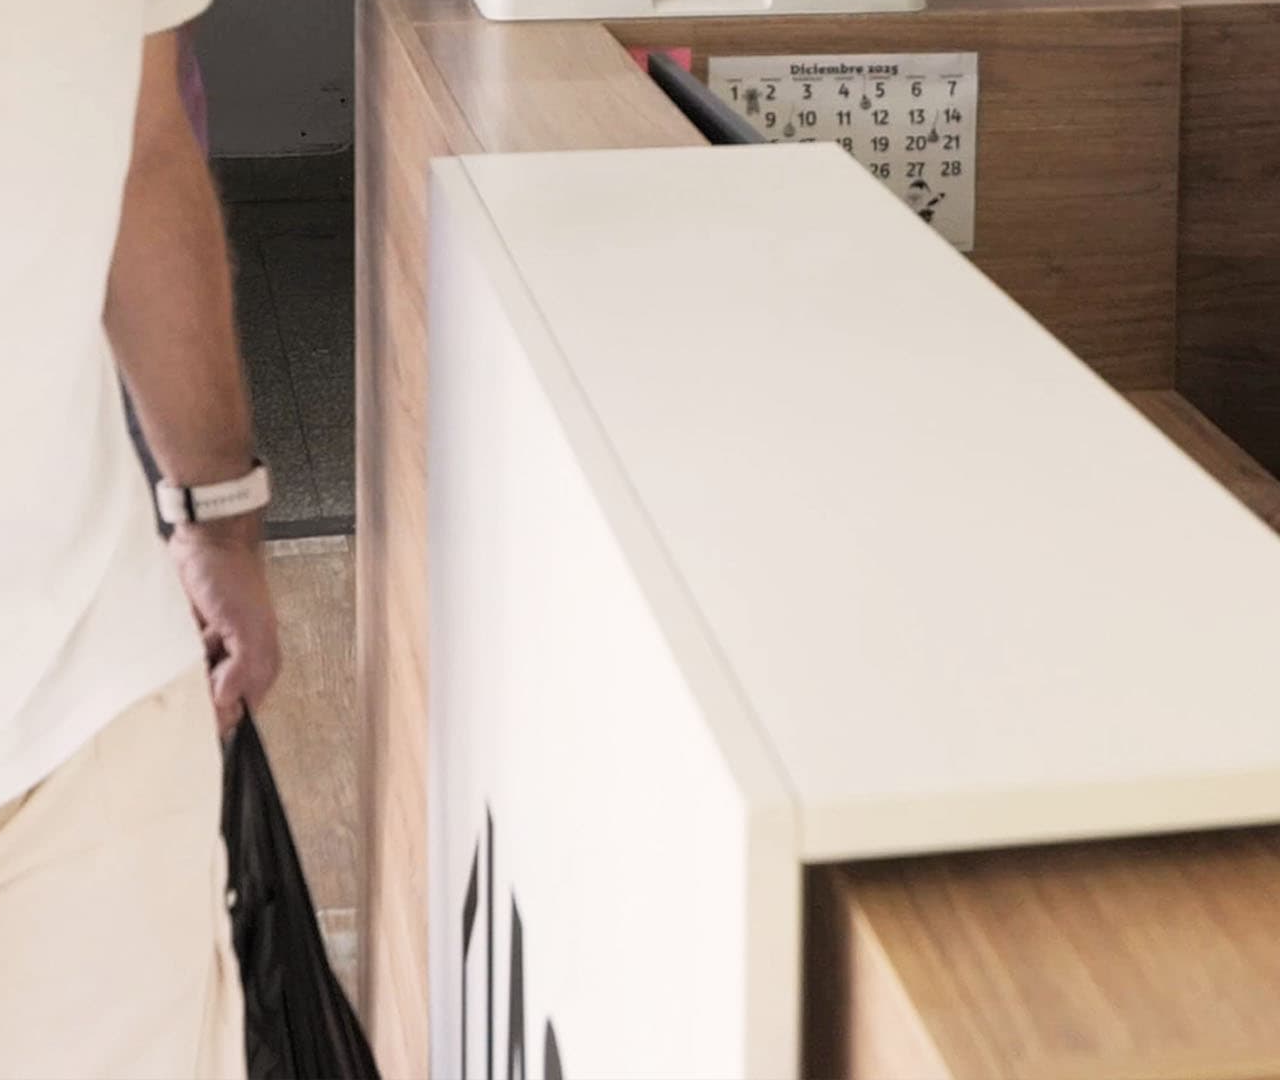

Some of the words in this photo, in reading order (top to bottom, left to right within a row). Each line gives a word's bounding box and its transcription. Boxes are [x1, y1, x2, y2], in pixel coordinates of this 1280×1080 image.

[790, 63, 864, 76] Diciembre
[867, 64, 899, 76] 2025
[730, 85, 739, 101] 1
[765, 85, 776, 101] 2
[802, 84, 813, 99] 3
[838, 83, 850, 98] 4
[875, 82, 886, 97] 5
[911, 81, 922, 97] 6
[948, 81, 957, 96] 7
[765, 112, 776, 128] 9
[798, 111, 817, 126] 10
[836, 110, 852, 126] 11
[871, 110, 889, 125] 12
[908, 109, 925, 124] 13
[944, 108, 962, 123] 14
[871, 136, 889, 151] 19
[905, 136, 927, 151] 20
[943, 135, 960, 150] 21
[905, 162, 925, 177] 27
[940, 161, 962, 176] 28
